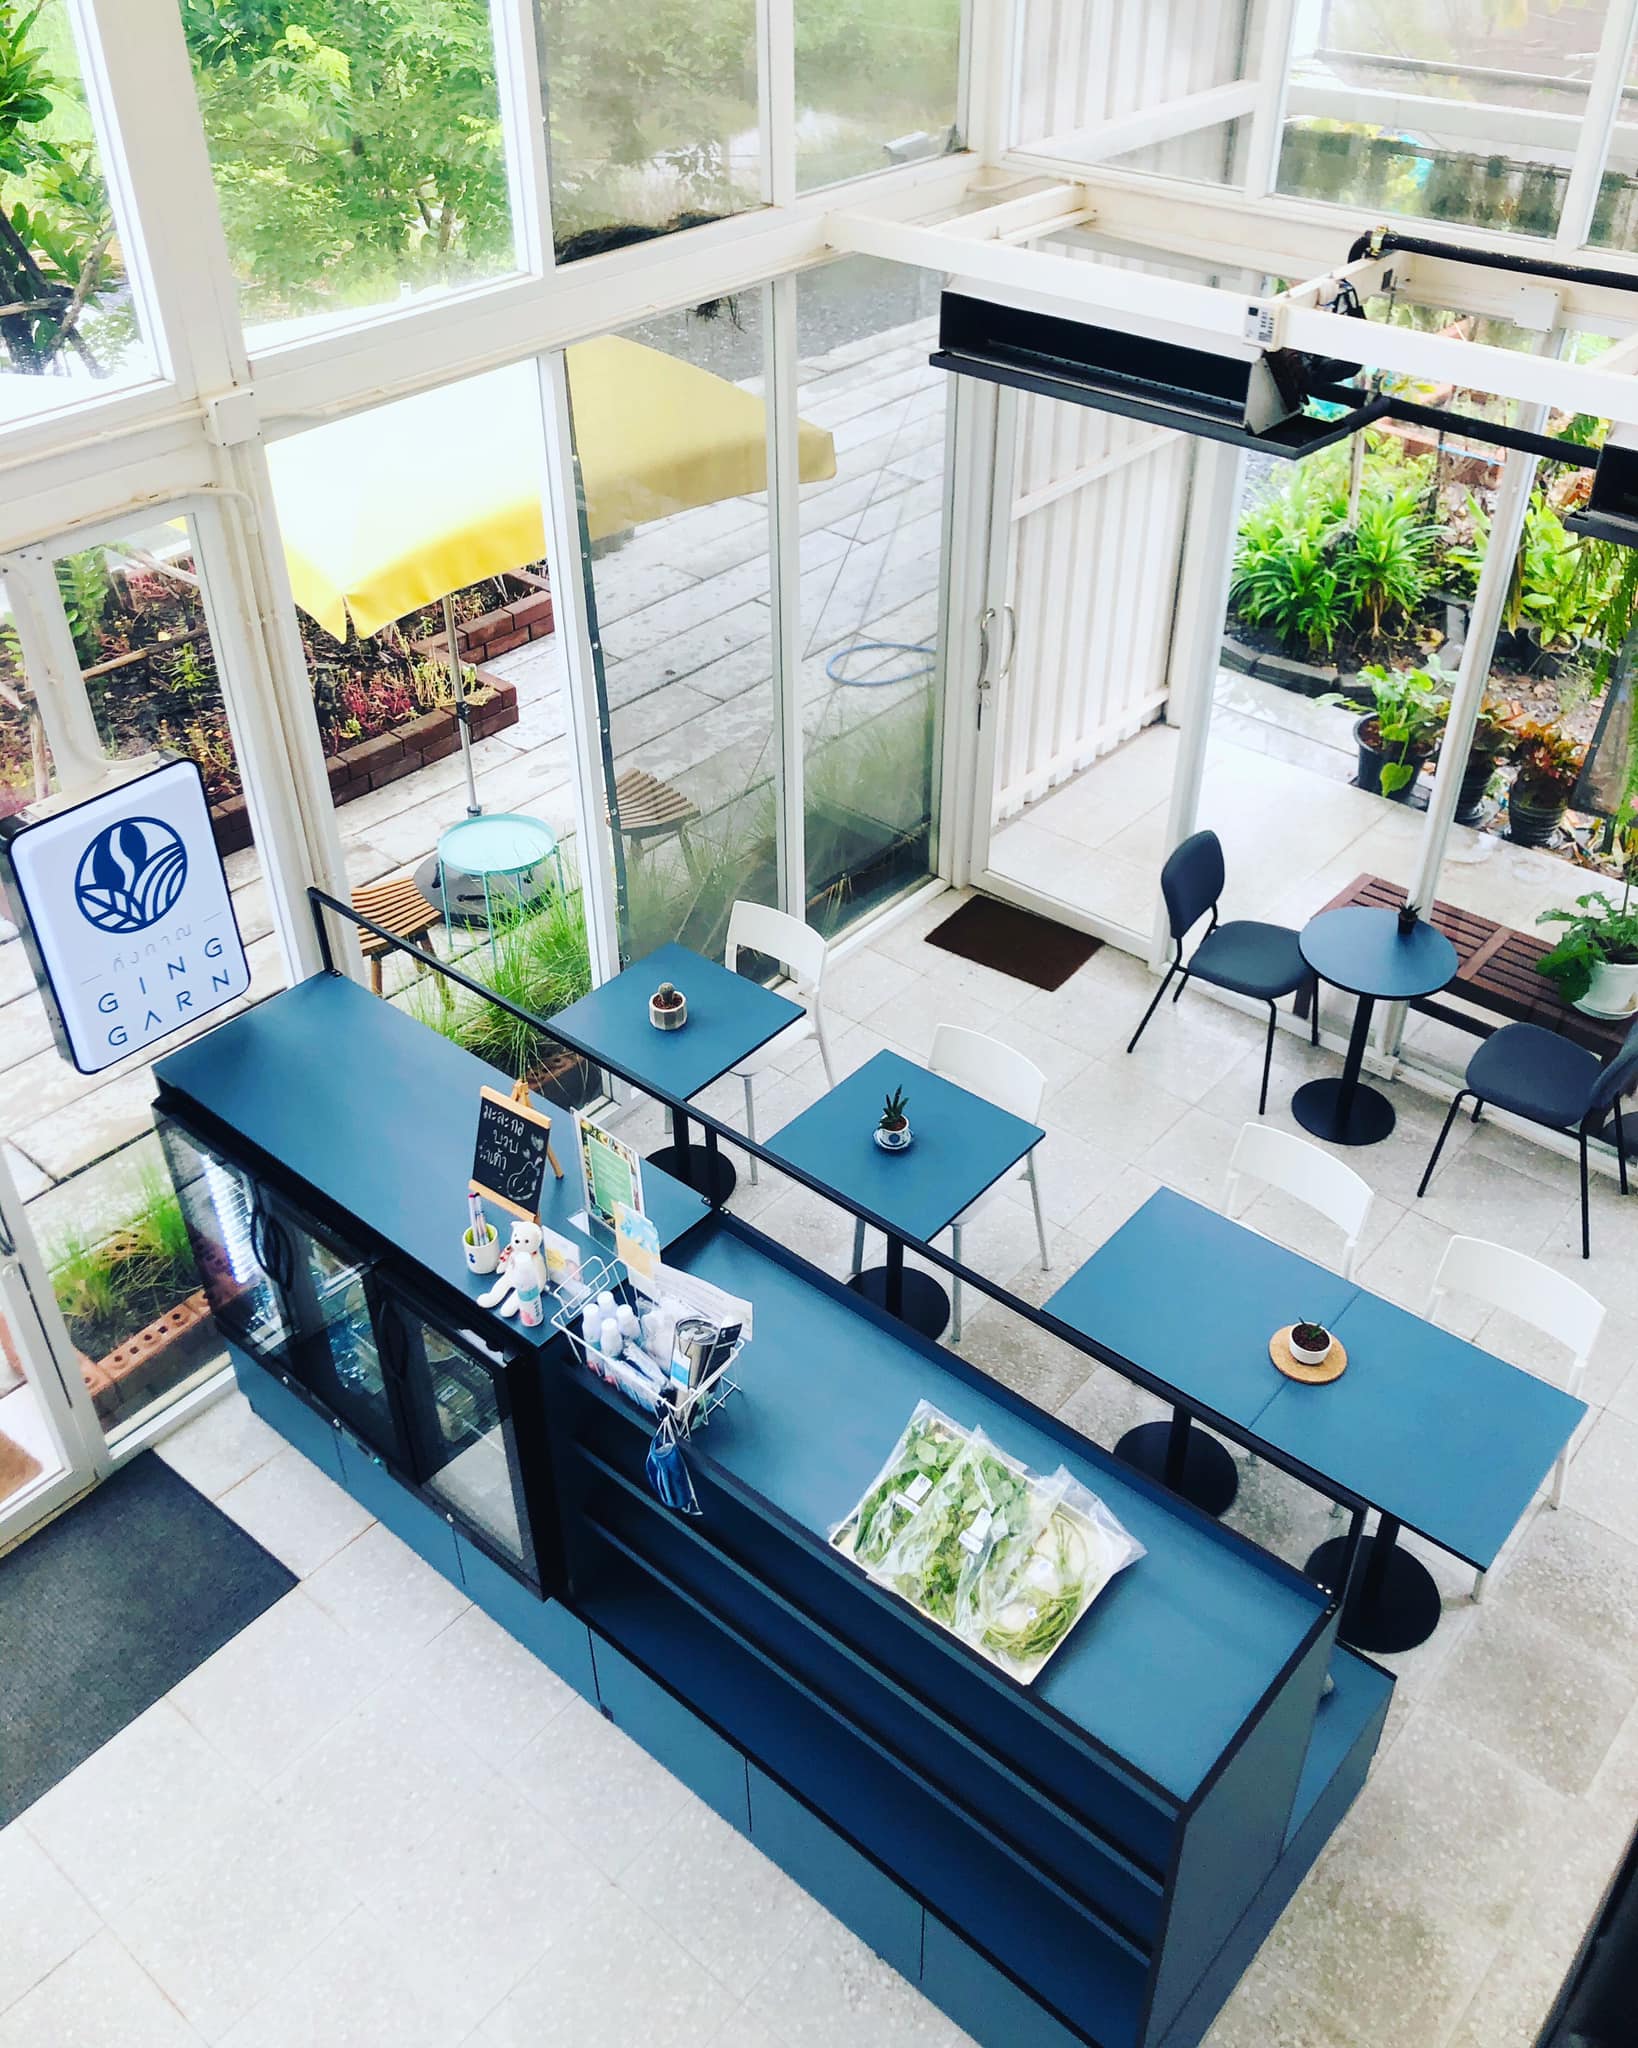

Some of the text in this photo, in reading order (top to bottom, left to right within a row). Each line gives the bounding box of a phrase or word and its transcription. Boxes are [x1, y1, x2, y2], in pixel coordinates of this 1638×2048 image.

[98, 937, 223, 1013] GING
[108, 968, 230, 1046] GARN
[483, 1104, 525, 1137] มะละกอ
